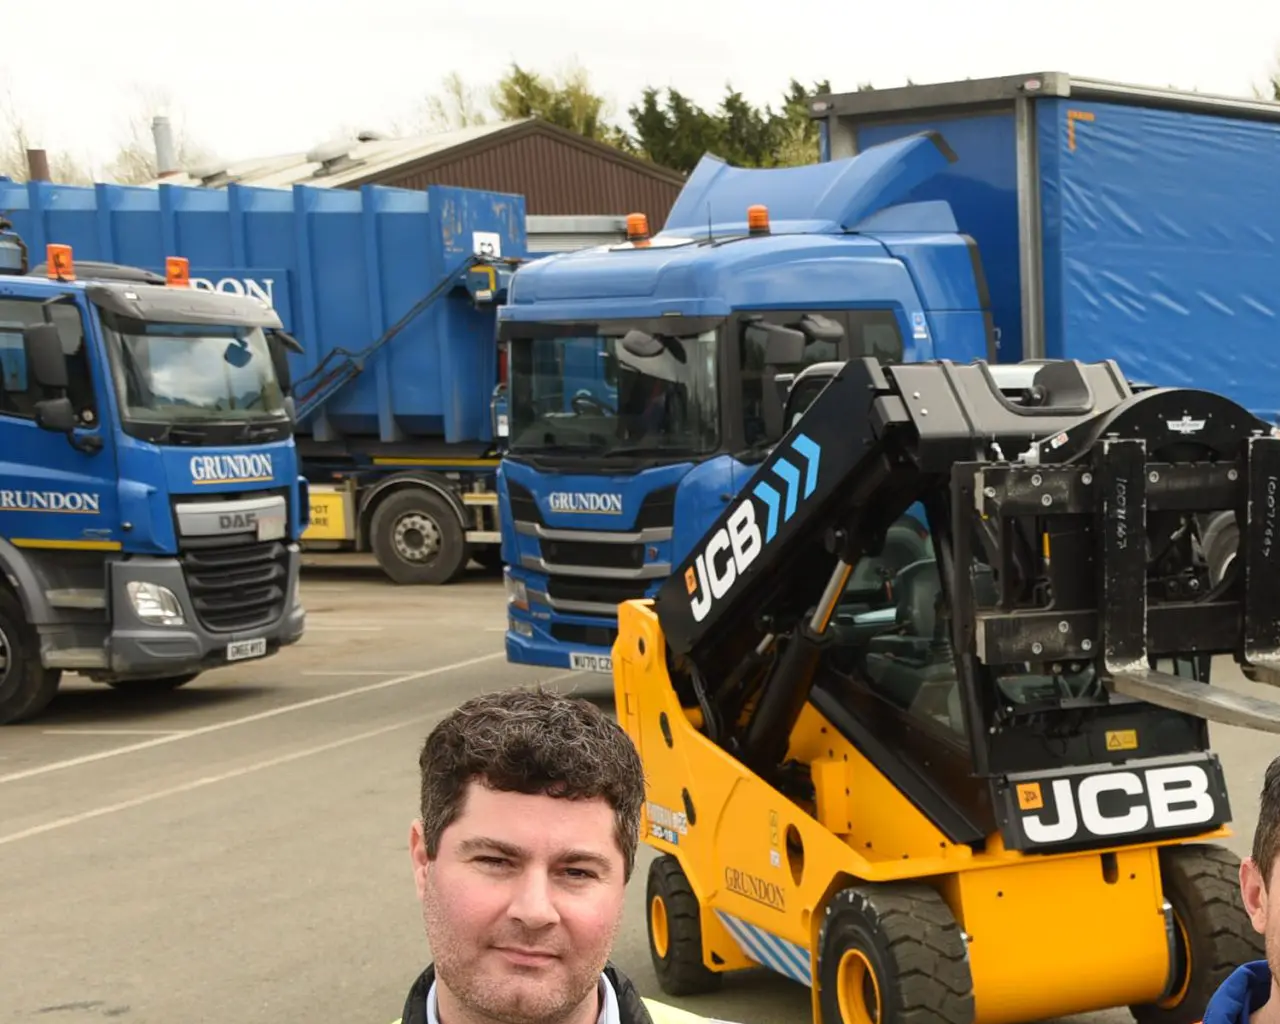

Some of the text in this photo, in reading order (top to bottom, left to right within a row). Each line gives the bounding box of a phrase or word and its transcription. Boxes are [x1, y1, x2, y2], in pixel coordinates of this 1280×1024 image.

[190, 453, 273, 480] GRUNDON
[549, 492, 622, 511] GRUNDON
[219, 513, 256, 529] DAF
[690, 499, 763, 622] JCB
[598, 657, 613, 671] CZ
[1022, 765, 1215, 843] JCB
[725, 867, 786, 908] GRUNDON
